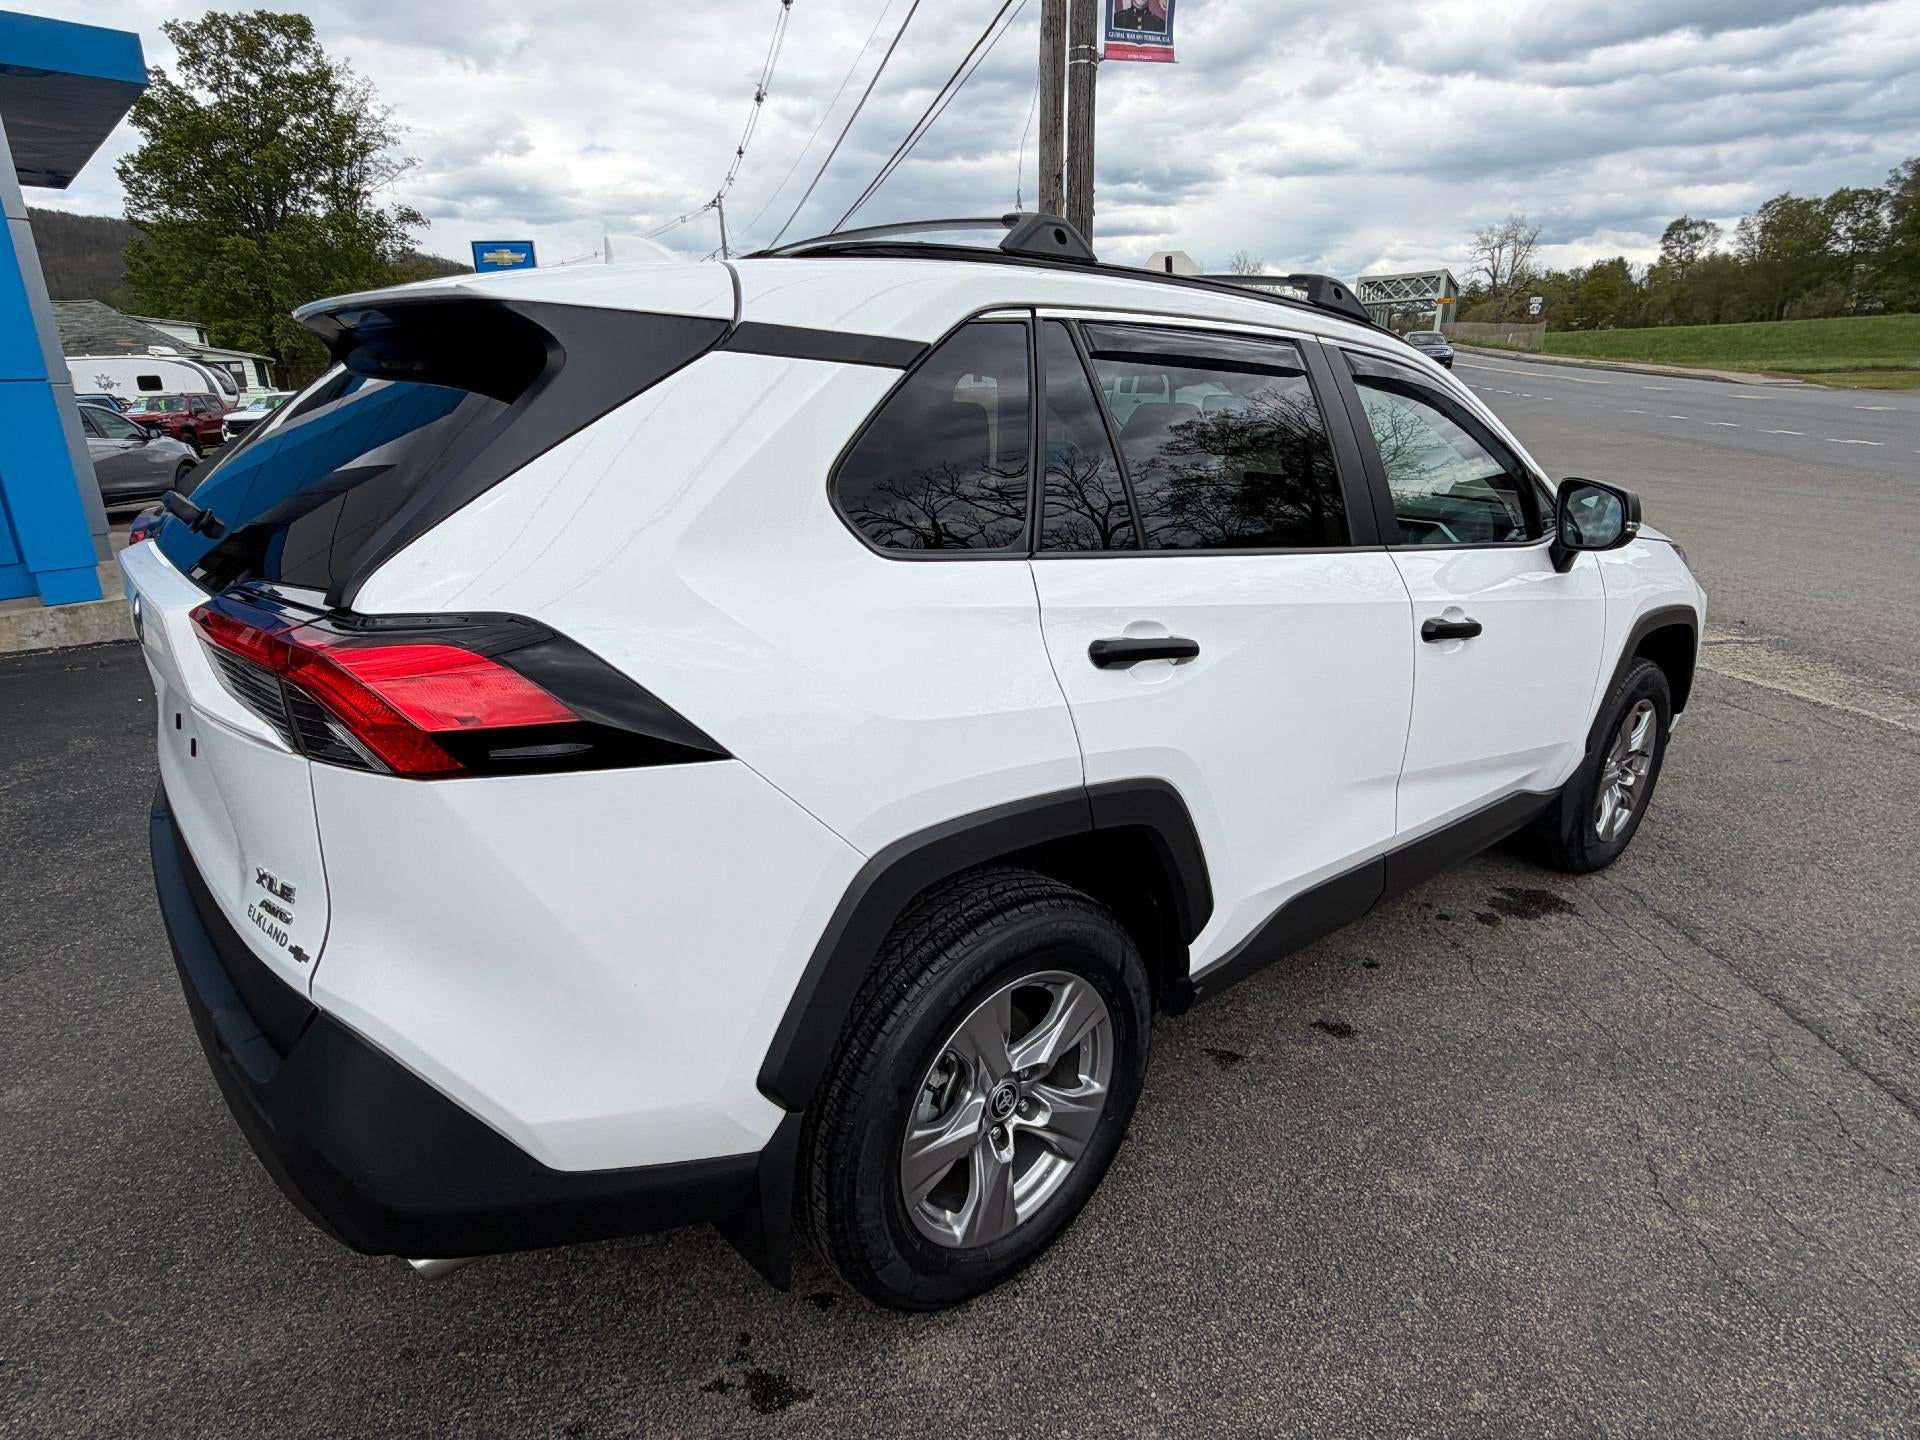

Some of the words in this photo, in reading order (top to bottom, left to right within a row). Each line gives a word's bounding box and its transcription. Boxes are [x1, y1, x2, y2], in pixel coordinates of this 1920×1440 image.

[256, 866, 296, 905] XLE
[247, 903, 289, 948] ELKLAND
[258, 898, 294, 926] AWD
